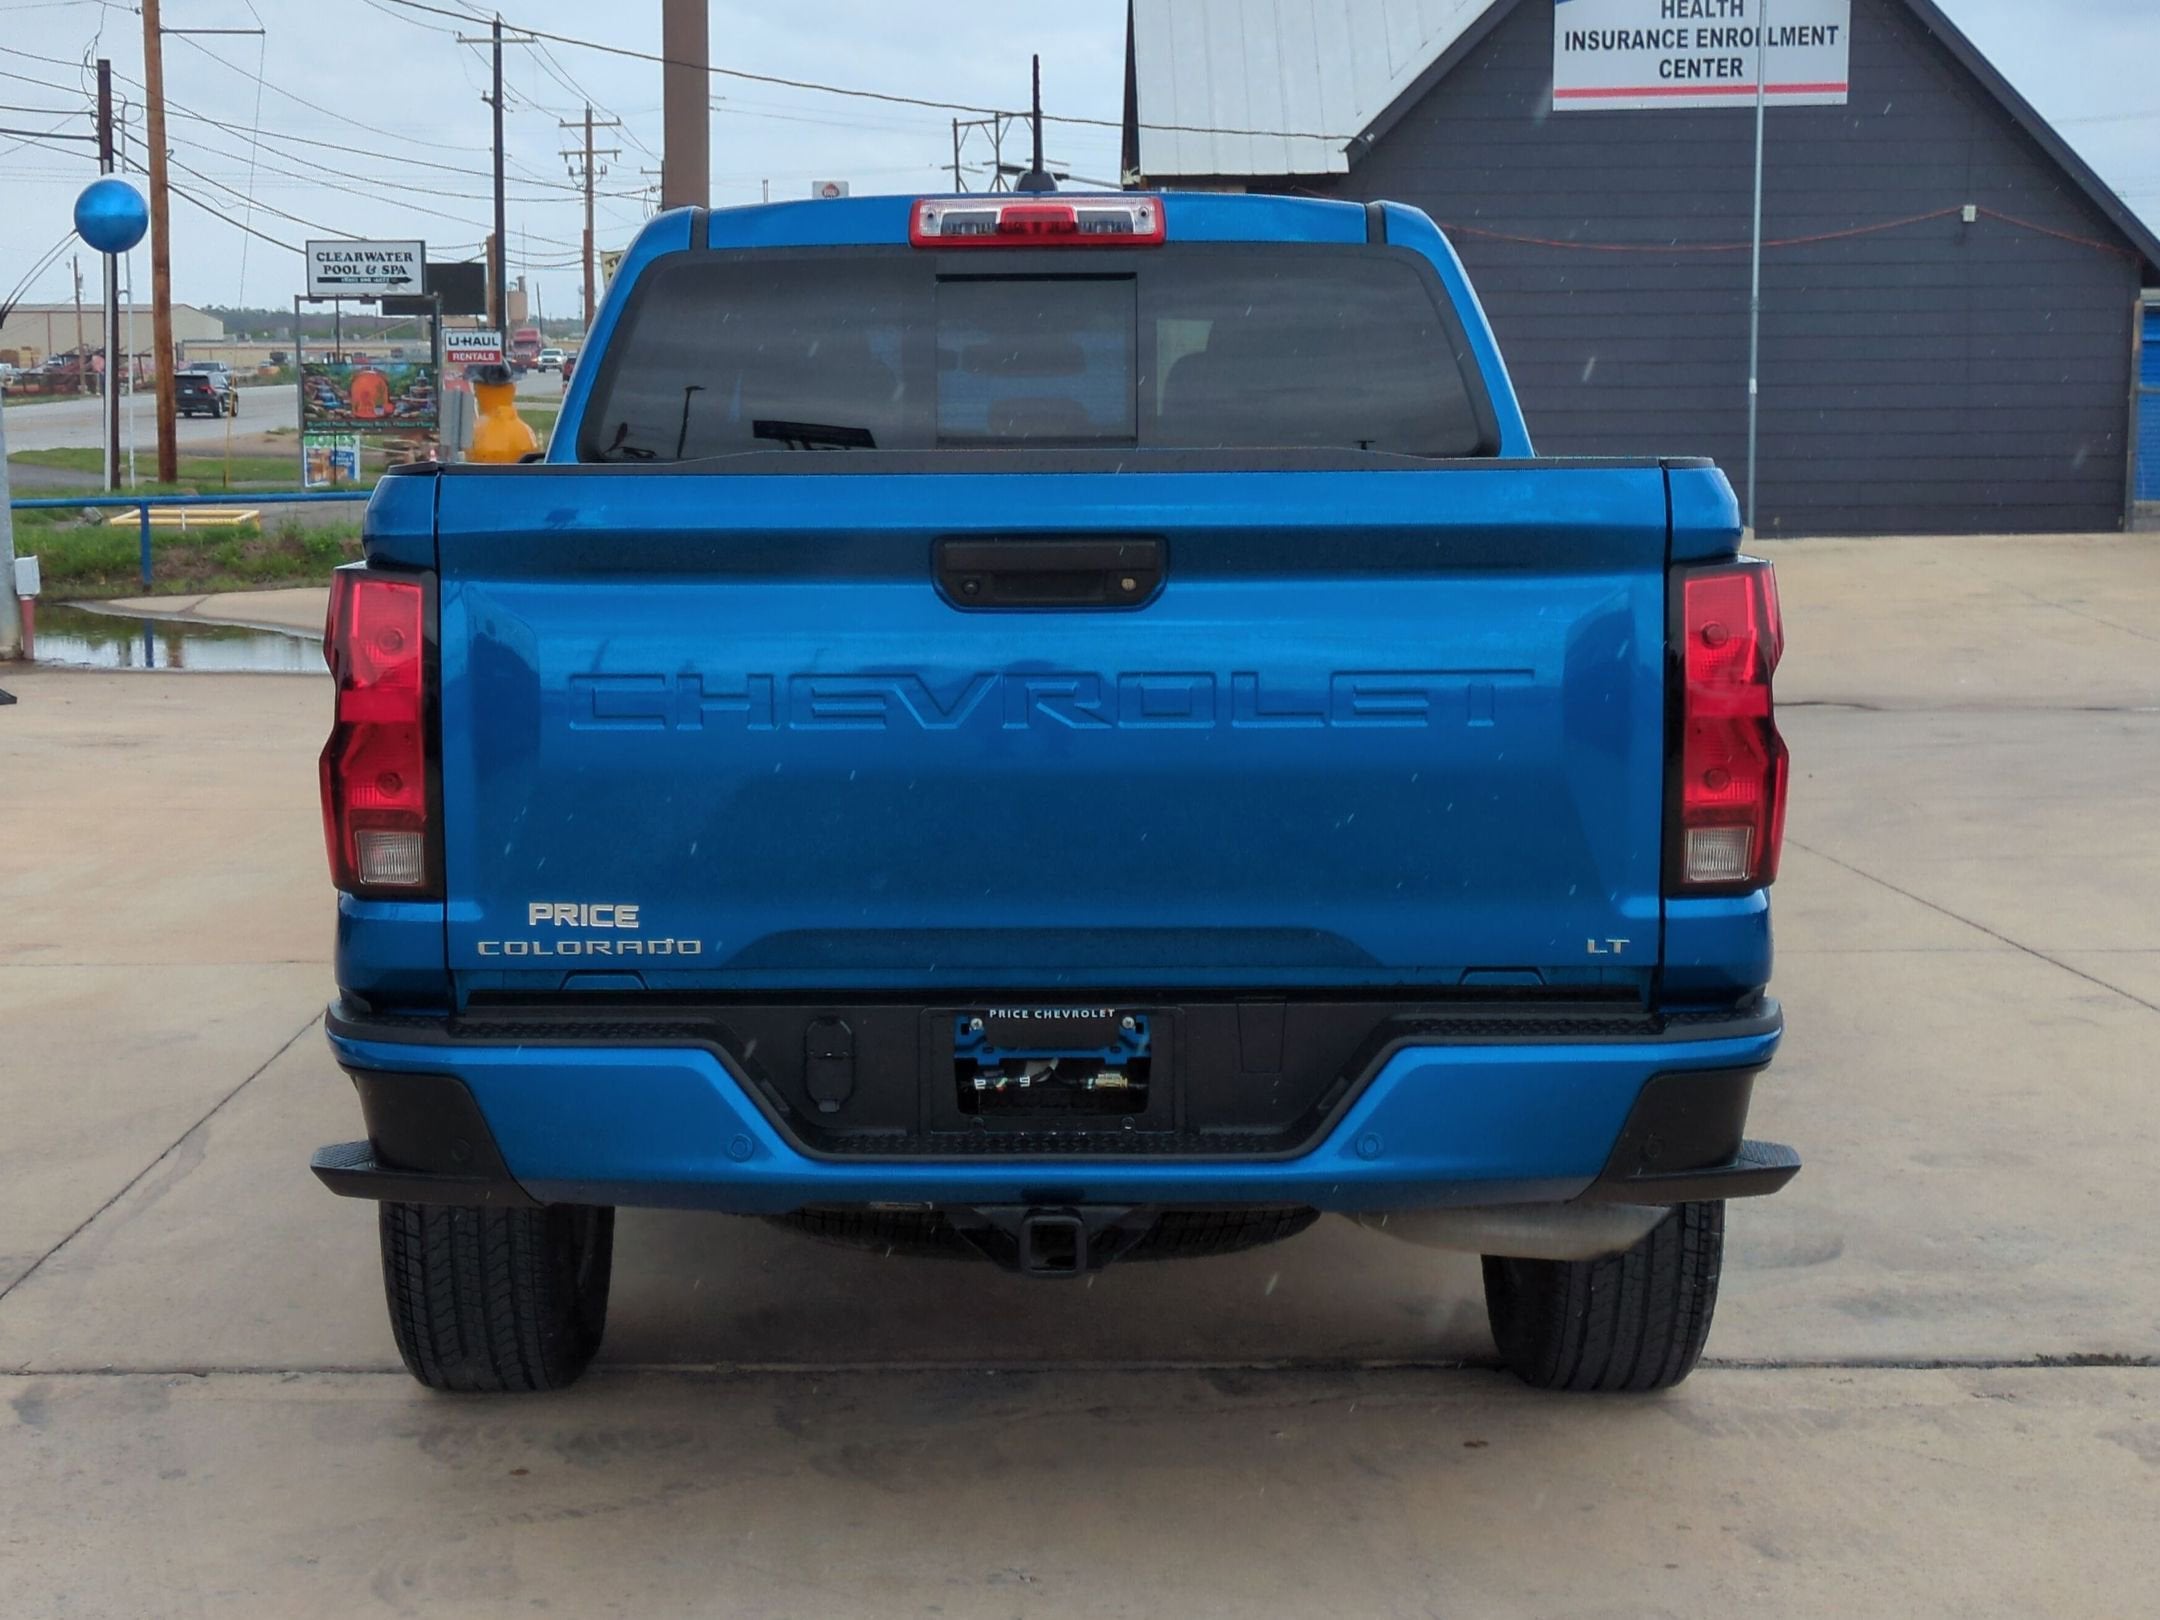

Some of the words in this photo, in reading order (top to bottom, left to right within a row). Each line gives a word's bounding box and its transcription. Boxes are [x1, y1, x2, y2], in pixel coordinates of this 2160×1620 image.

[1661, 0, 1744, 19] HEALTH
[1565, 28, 1689, 51] INSURANCE
[1659, 57, 1743, 79] CENTER
[316, 252, 413, 263] CLEARWATER
[323, 264, 361, 275] POOL
[365, 264, 377, 275] &
[381, 264, 407, 275] SPA
[448, 336, 499, 347] U-HAUL
[452, 352, 496, 361] RENTALS
[568, 669, 1535, 732] CHEVROLET
[528, 902, 640, 929] PRICE
[477, 939, 702, 956] COLORADO
[1586, 938, 1632, 954] LT
[989, 1009, 1029, 1019] PRICE
[1034, 1008, 1115, 1019] CHEVROLET
